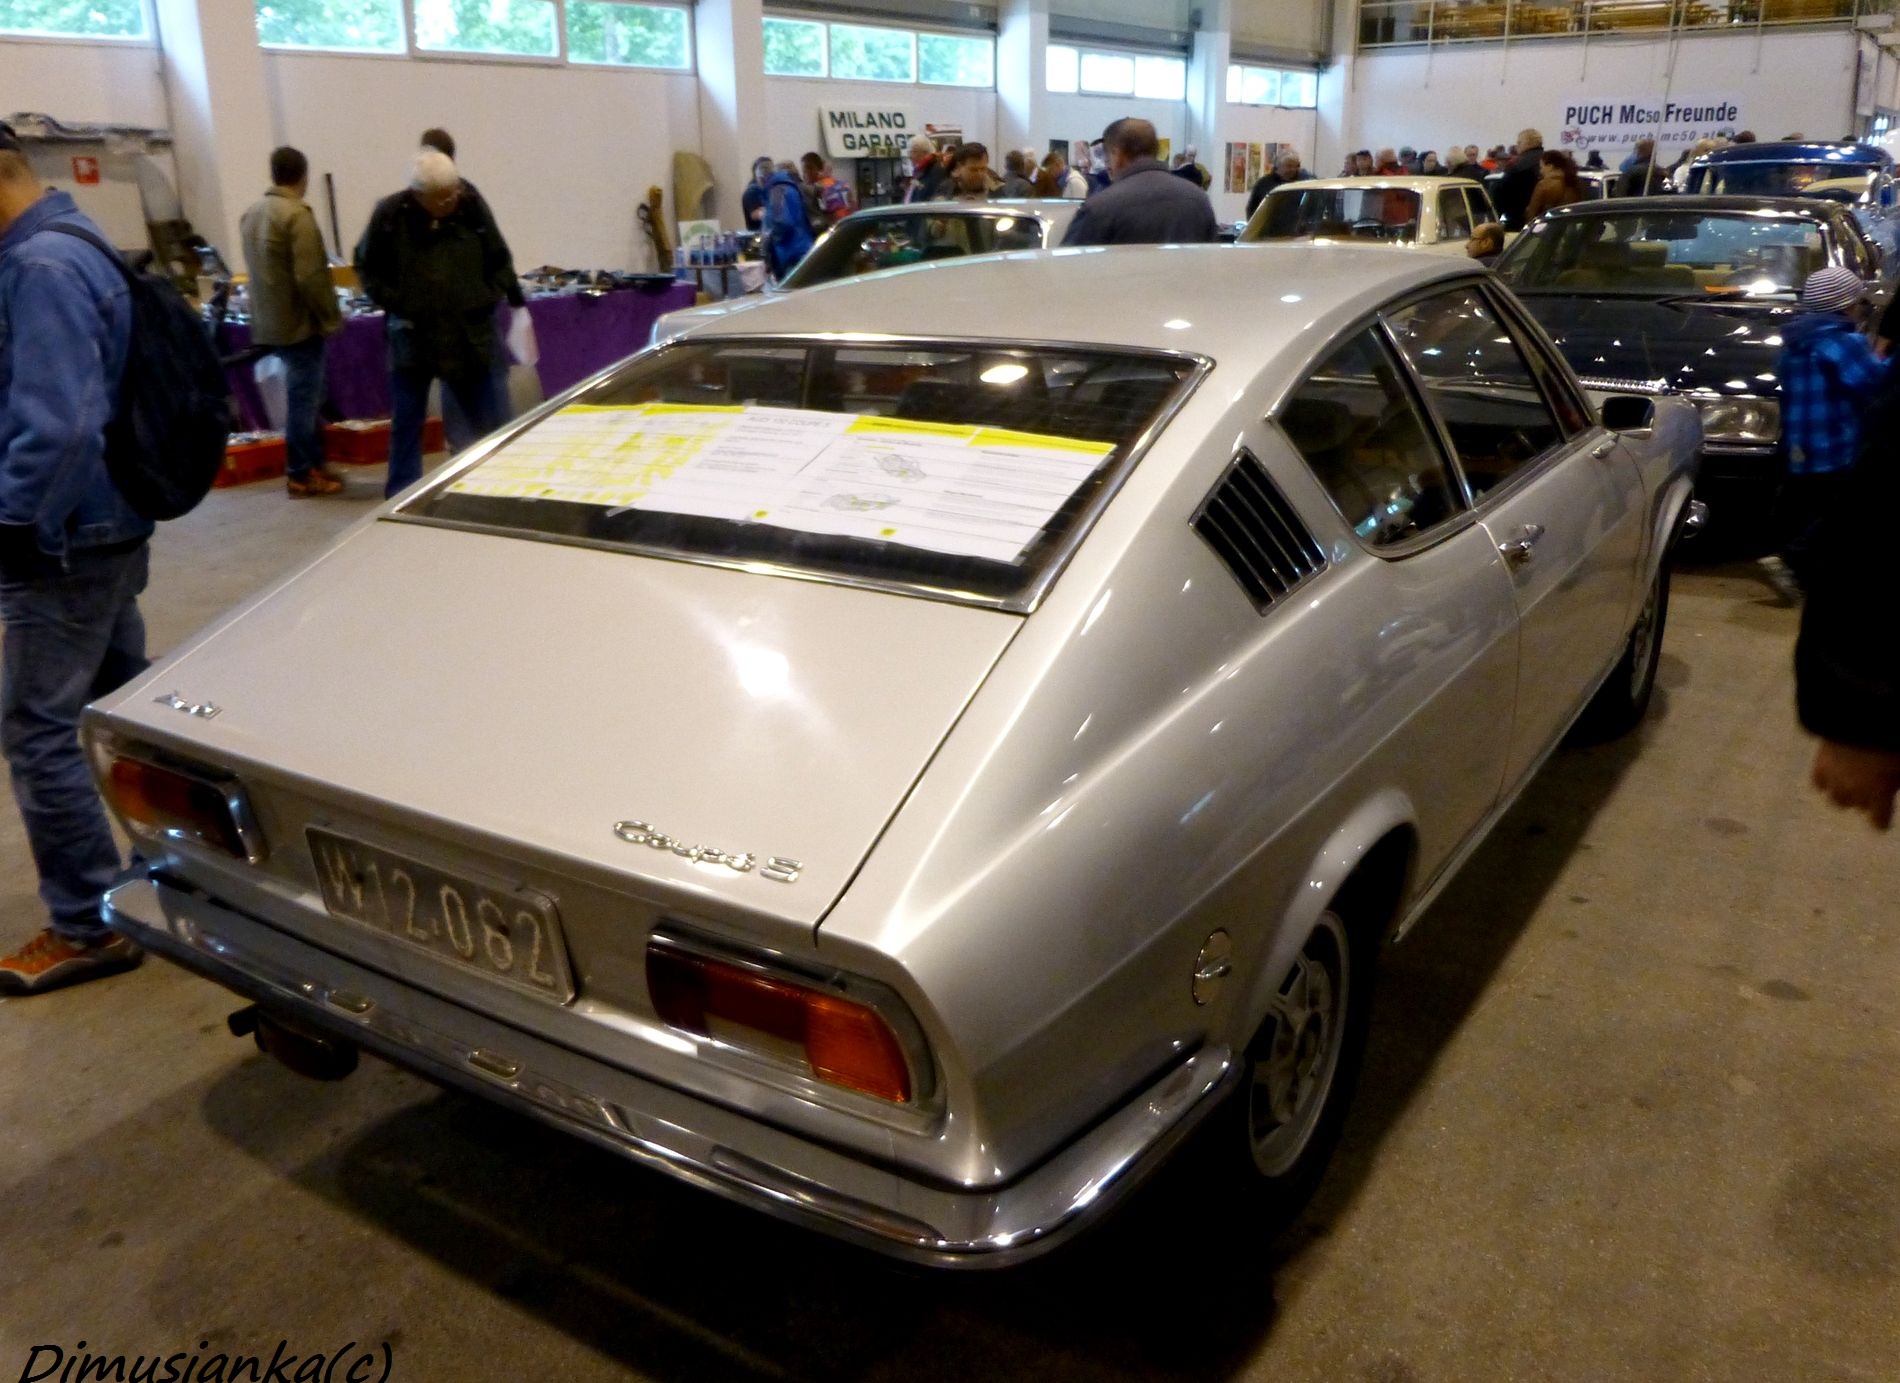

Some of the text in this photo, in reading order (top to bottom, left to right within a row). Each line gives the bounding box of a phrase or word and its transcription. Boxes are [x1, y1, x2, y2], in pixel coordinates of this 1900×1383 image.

[829, 111, 906, 128] MILANO
[1565, 101, 1738, 125] PUCH Mc50 Freunde
